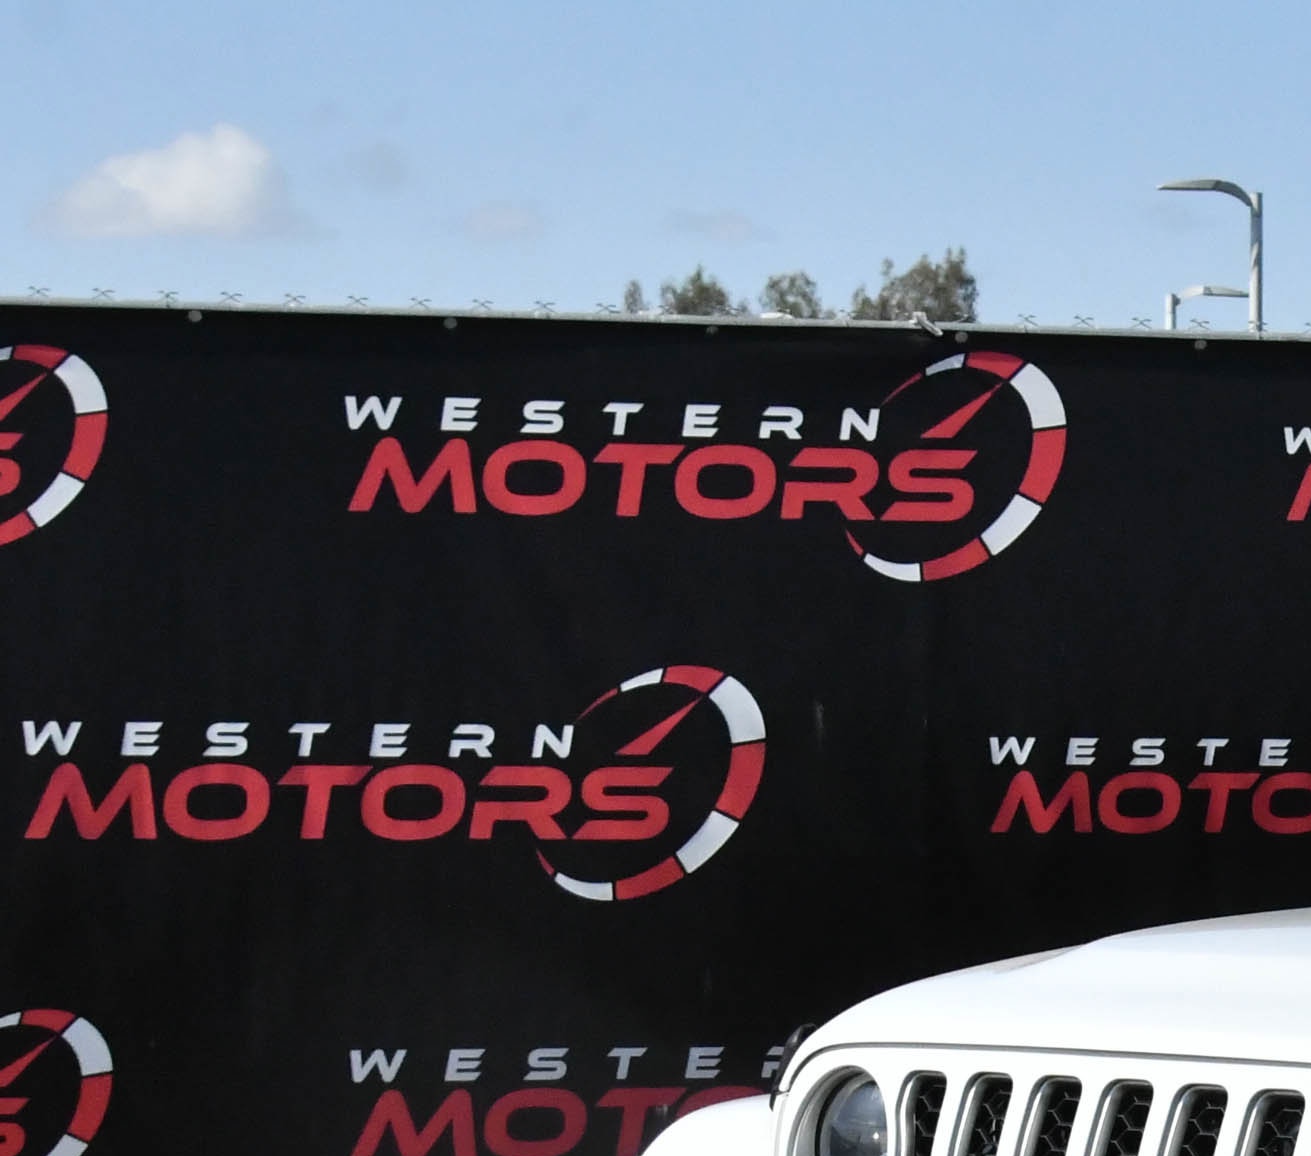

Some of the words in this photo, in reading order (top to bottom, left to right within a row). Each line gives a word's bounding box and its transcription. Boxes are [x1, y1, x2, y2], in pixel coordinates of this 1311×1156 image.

[345, 396, 880, 440] WESTERN
[348, 437, 977, 522] MOTORS
[23, 721, 574, 758] WESTERN
[24, 763, 673, 840] MOTORS
